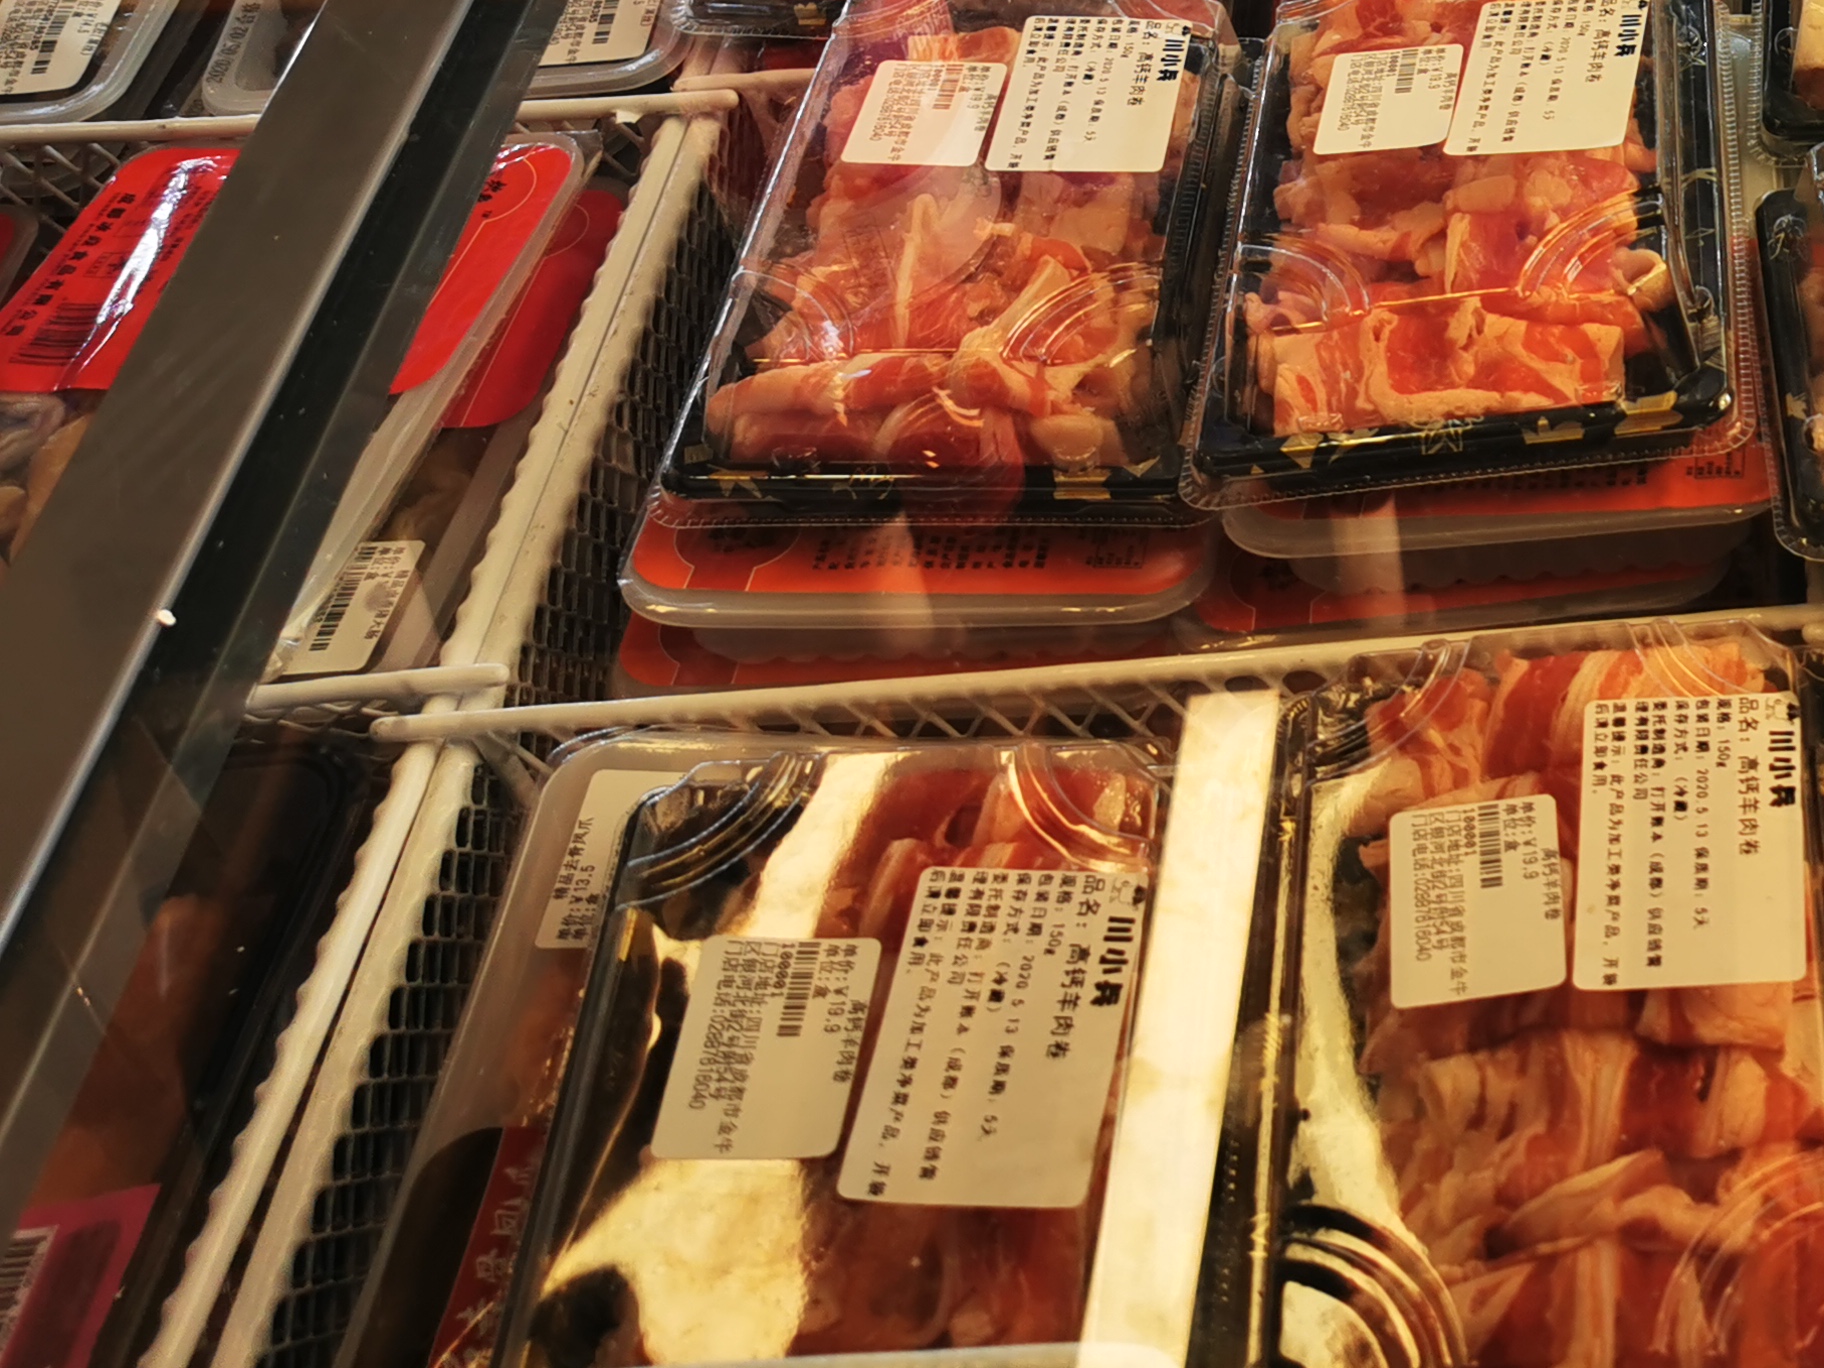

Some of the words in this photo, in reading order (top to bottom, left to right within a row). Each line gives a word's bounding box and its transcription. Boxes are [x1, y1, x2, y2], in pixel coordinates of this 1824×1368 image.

[1156, 39, 1186, 82] 川小兵
[1613, 14, 1643, 57] 川小兵
[1738, 697, 1760, 855] 品名：高钙羊肉卷
[1768, 731, 1796, 807] 川小兵
[1463, 808, 1477, 857] 100001
[770, 942, 795, 998] 100001
[1046, 875, 1105, 1060] 品名：高钙羊肉卷
[1090, 916, 1136, 1006] 川小兵
